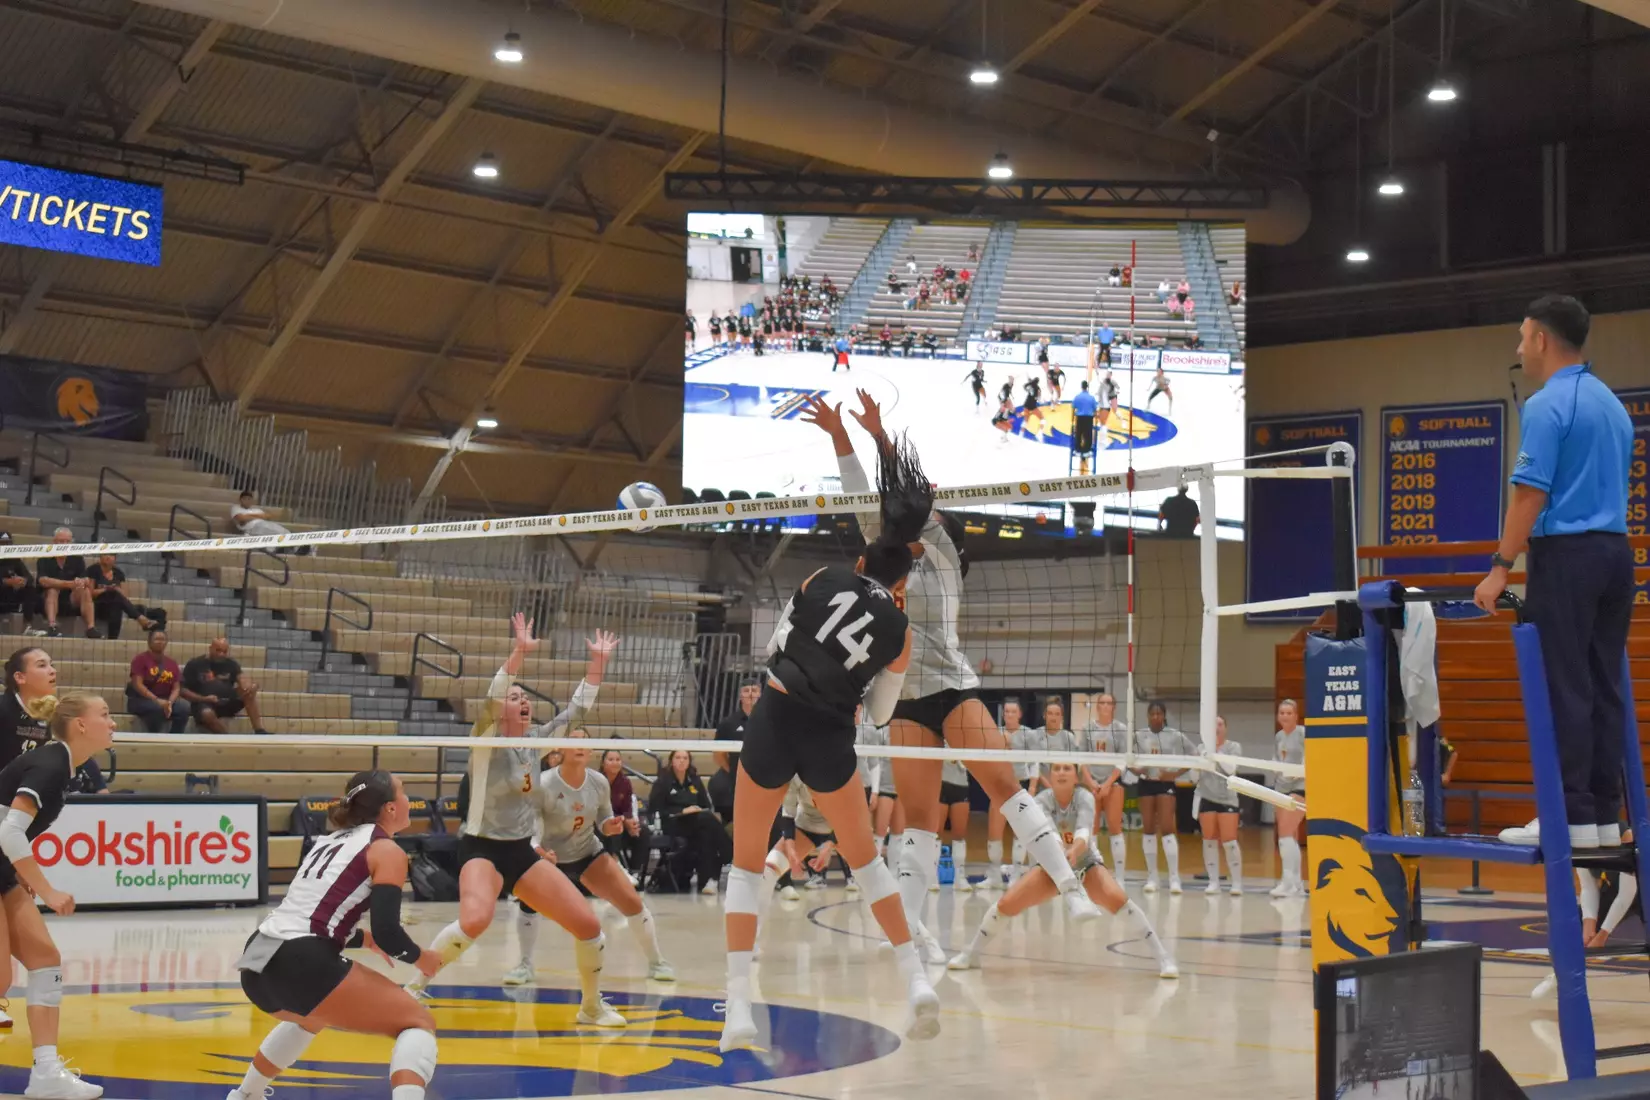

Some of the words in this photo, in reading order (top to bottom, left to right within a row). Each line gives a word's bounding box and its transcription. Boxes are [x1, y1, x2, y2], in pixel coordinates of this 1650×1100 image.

[1418, 417, 1492, 431] SOFTBALL
[1281, 425, 1347, 441] SOFTBALL
[1389, 440, 1419, 452] NCAA
[1422, 437, 1496, 449] TOURNAMENT
[1391, 453, 1436, 469] 2016
[1038, 482, 1063, 493] EAST
[1065, 478, 1098, 491] TEXAS
[1391, 473, 1436, 490] 2018
[832, 497, 855, 506] EAST
[857, 495, 881, 505] TEXA
[933, 489, 956, 500] EAST
[958, 487, 989, 498] TEXAS
[741, 502, 762, 512] EAST
[763, 501, 790, 511] TEXAS
[1391, 494, 1436, 511] 2019
[572, 516, 591, 524] EAST
[593, 514, 616, 523] TEXAS
[654, 509, 674, 518] EAST
[676, 507, 700, 517] TEXAS
[1391, 514, 1434, 530] 2021
[815, 591, 874, 671] 14
[1328, 665, 1357, 676] EAST
[1325, 680, 1360, 692] TEXAS
[1323, 694, 1362, 712] A&M
[522, 773, 533, 792] 3
[573, 816, 585, 832] 2
[32, 816, 252, 867] ookshire's
[302, 843, 345, 879] 11
